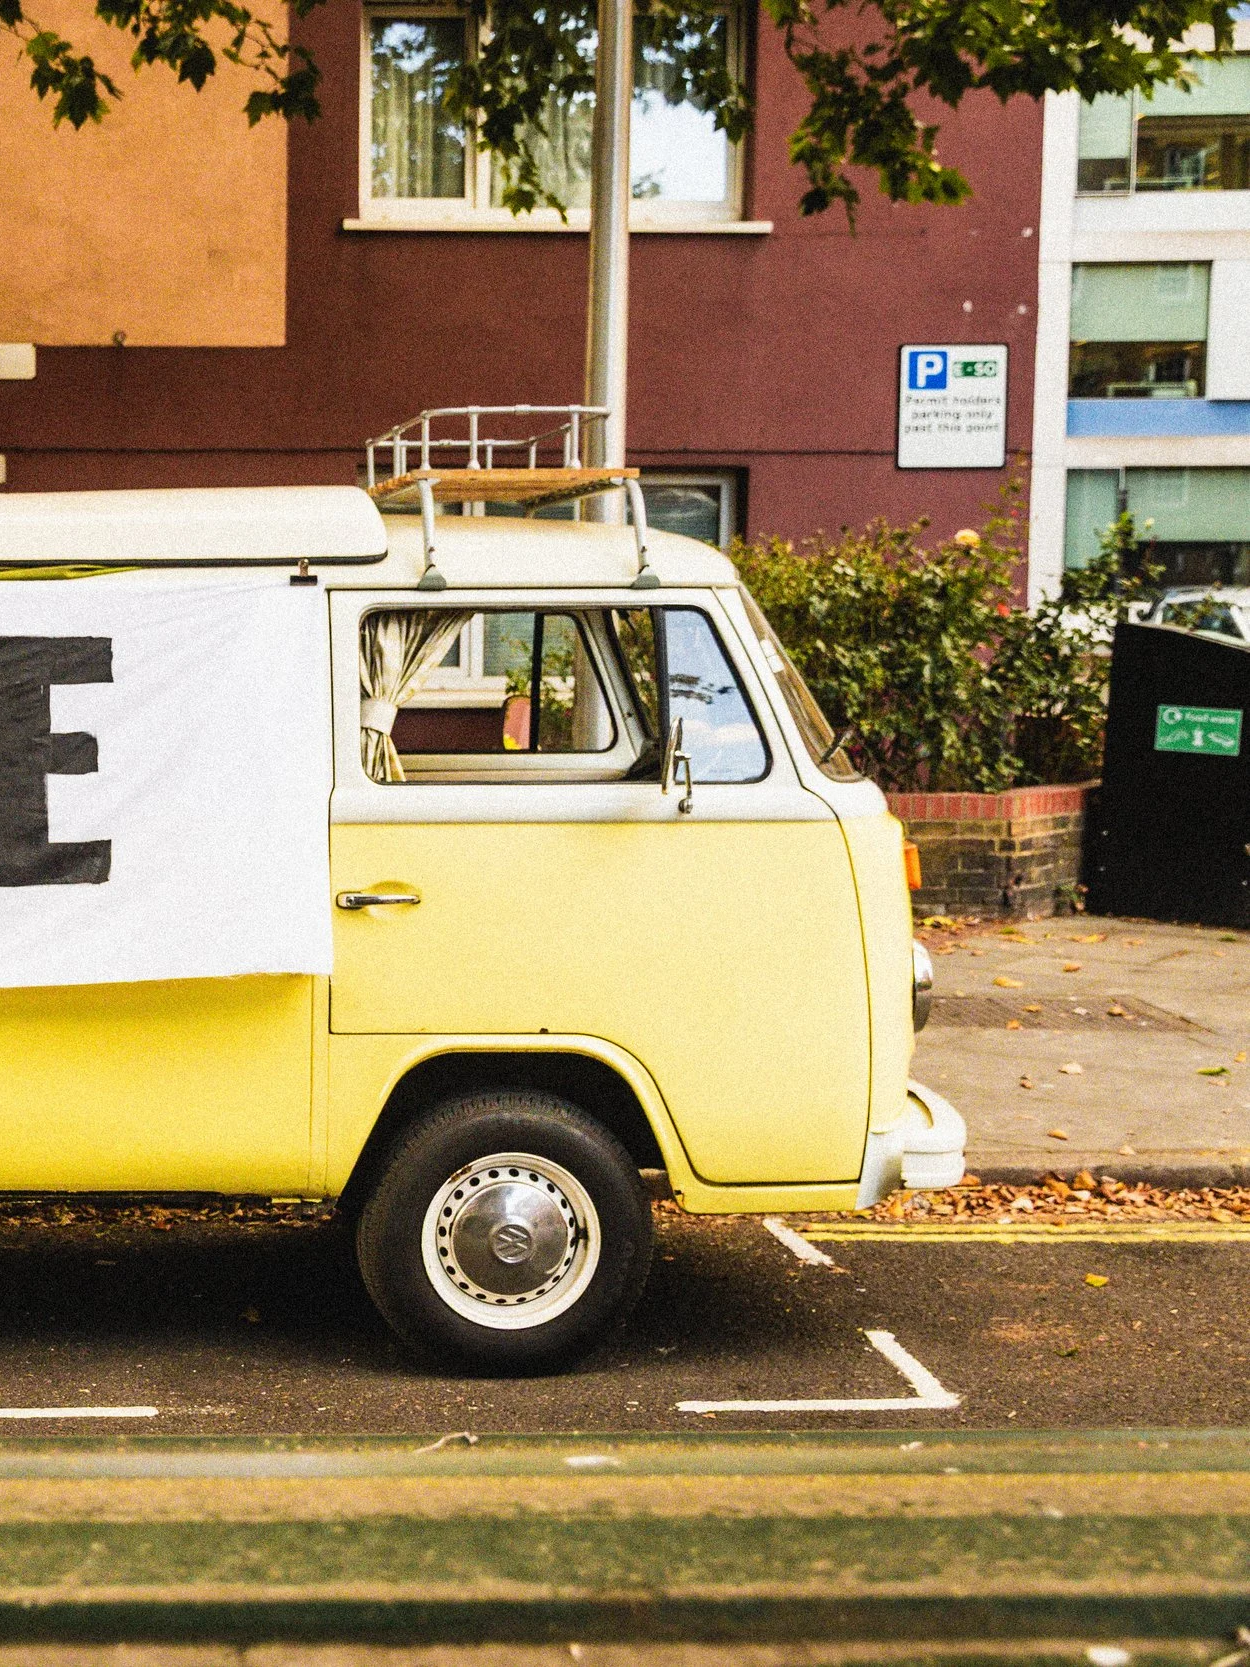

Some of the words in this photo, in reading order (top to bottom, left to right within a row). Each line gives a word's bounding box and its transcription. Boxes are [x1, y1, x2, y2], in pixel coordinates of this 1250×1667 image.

[916, 353, 944, 388] P
[905, 395, 948, 405] Permit
[953, 395, 1000, 405] holders
[911, 410, 961, 420] parking
[967, 410, 993, 420] only
[904, 423, 932, 433] past
[937, 423, 962, 432] this
[966, 423, 1000, 433] point
